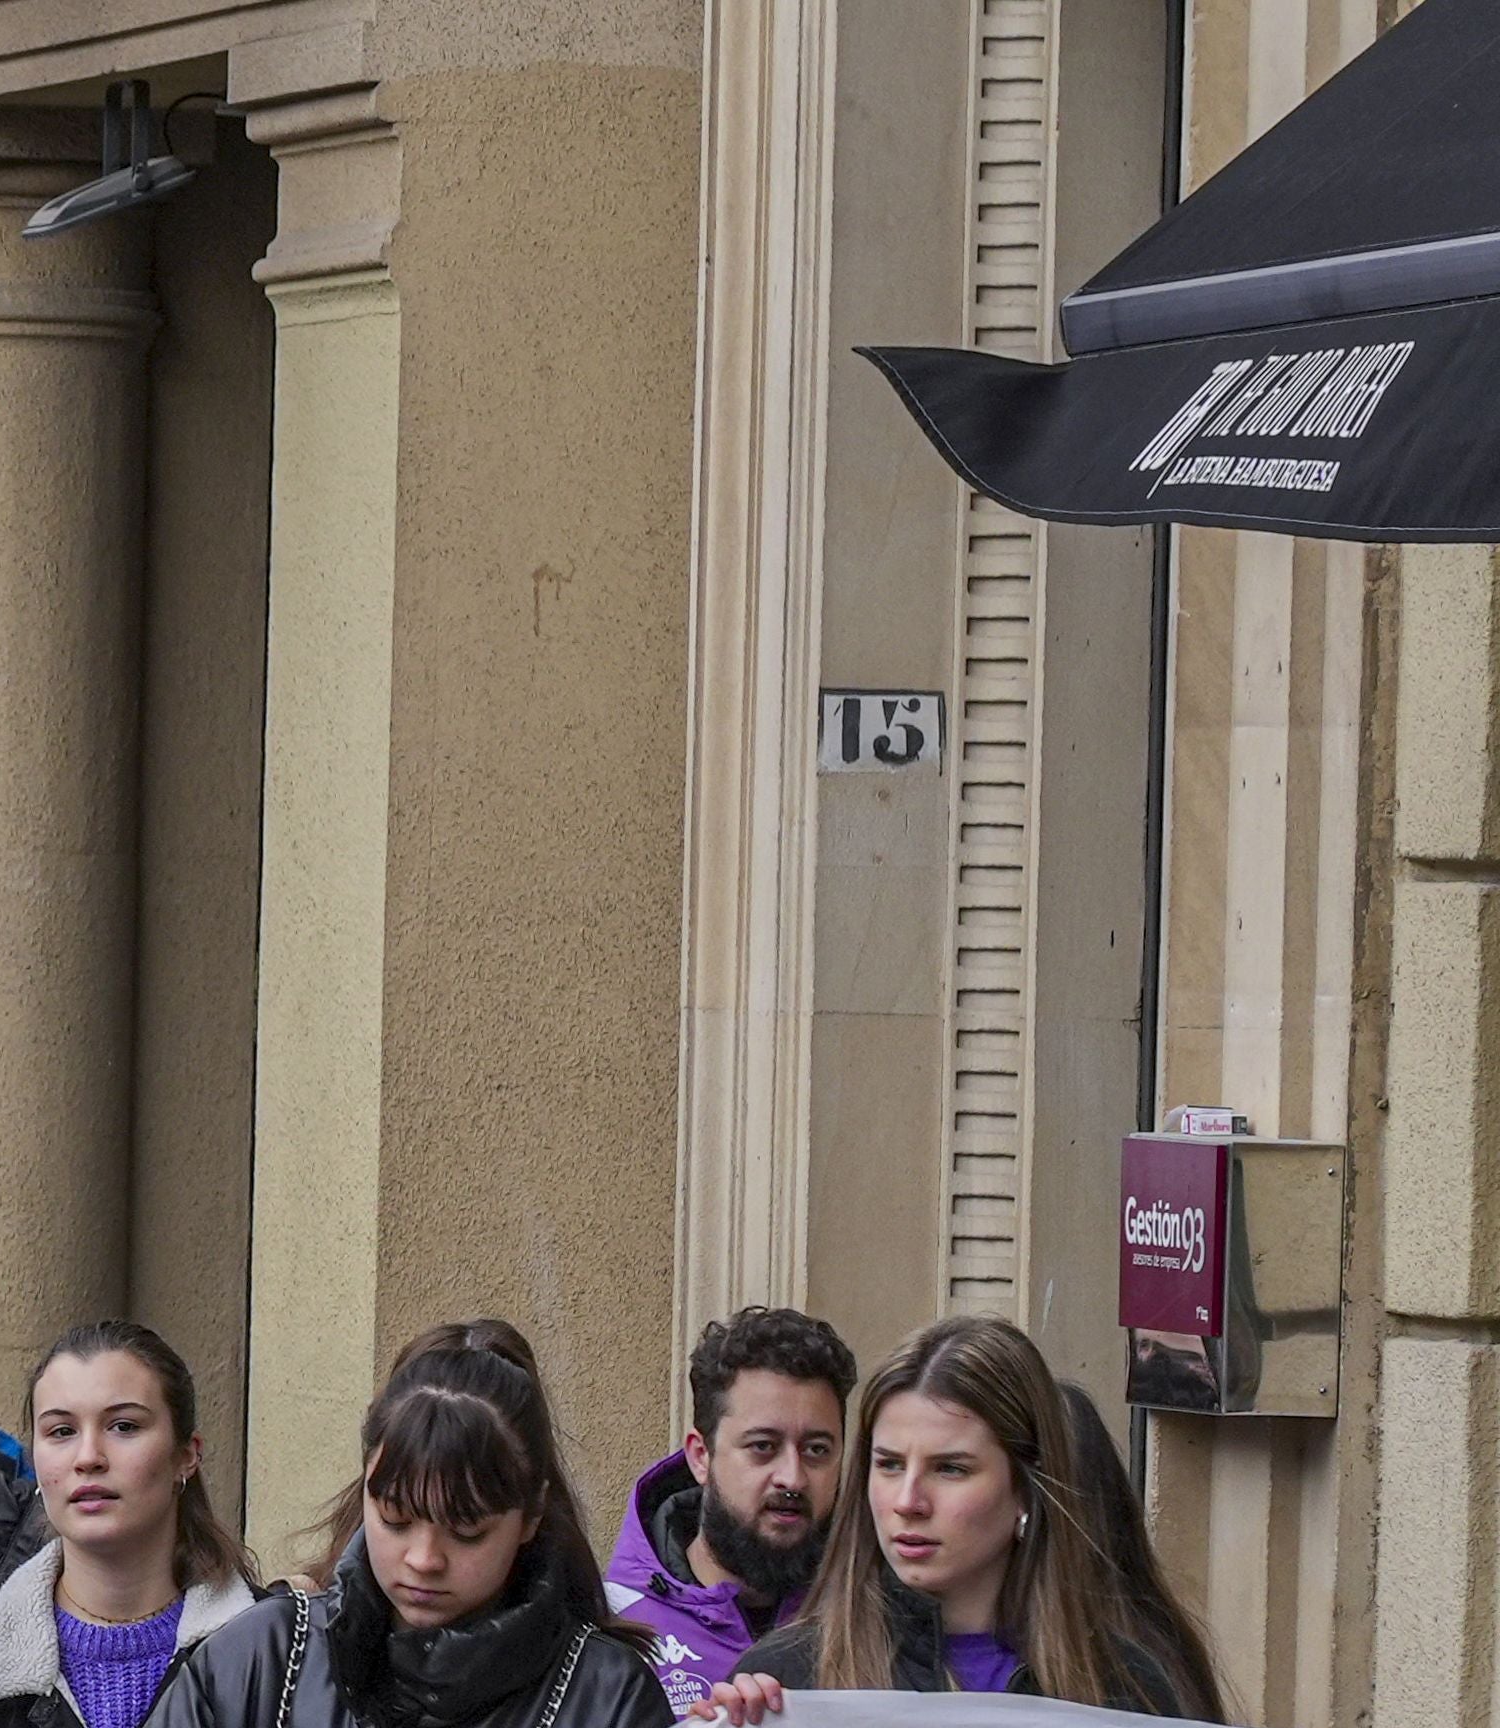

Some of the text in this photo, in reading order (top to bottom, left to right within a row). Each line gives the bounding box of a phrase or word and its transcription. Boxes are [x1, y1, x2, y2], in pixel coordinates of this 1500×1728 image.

[1201, 340, 1416, 438] THE GOOD BURGER
[1161, 456, 1341, 492] LA BUENA HAMBURGUESA
[834, 697, 924, 766] 15
[1124, 1196, 1206, 1273] Gestión 93
[667, 1692, 703, 1706] alicia
